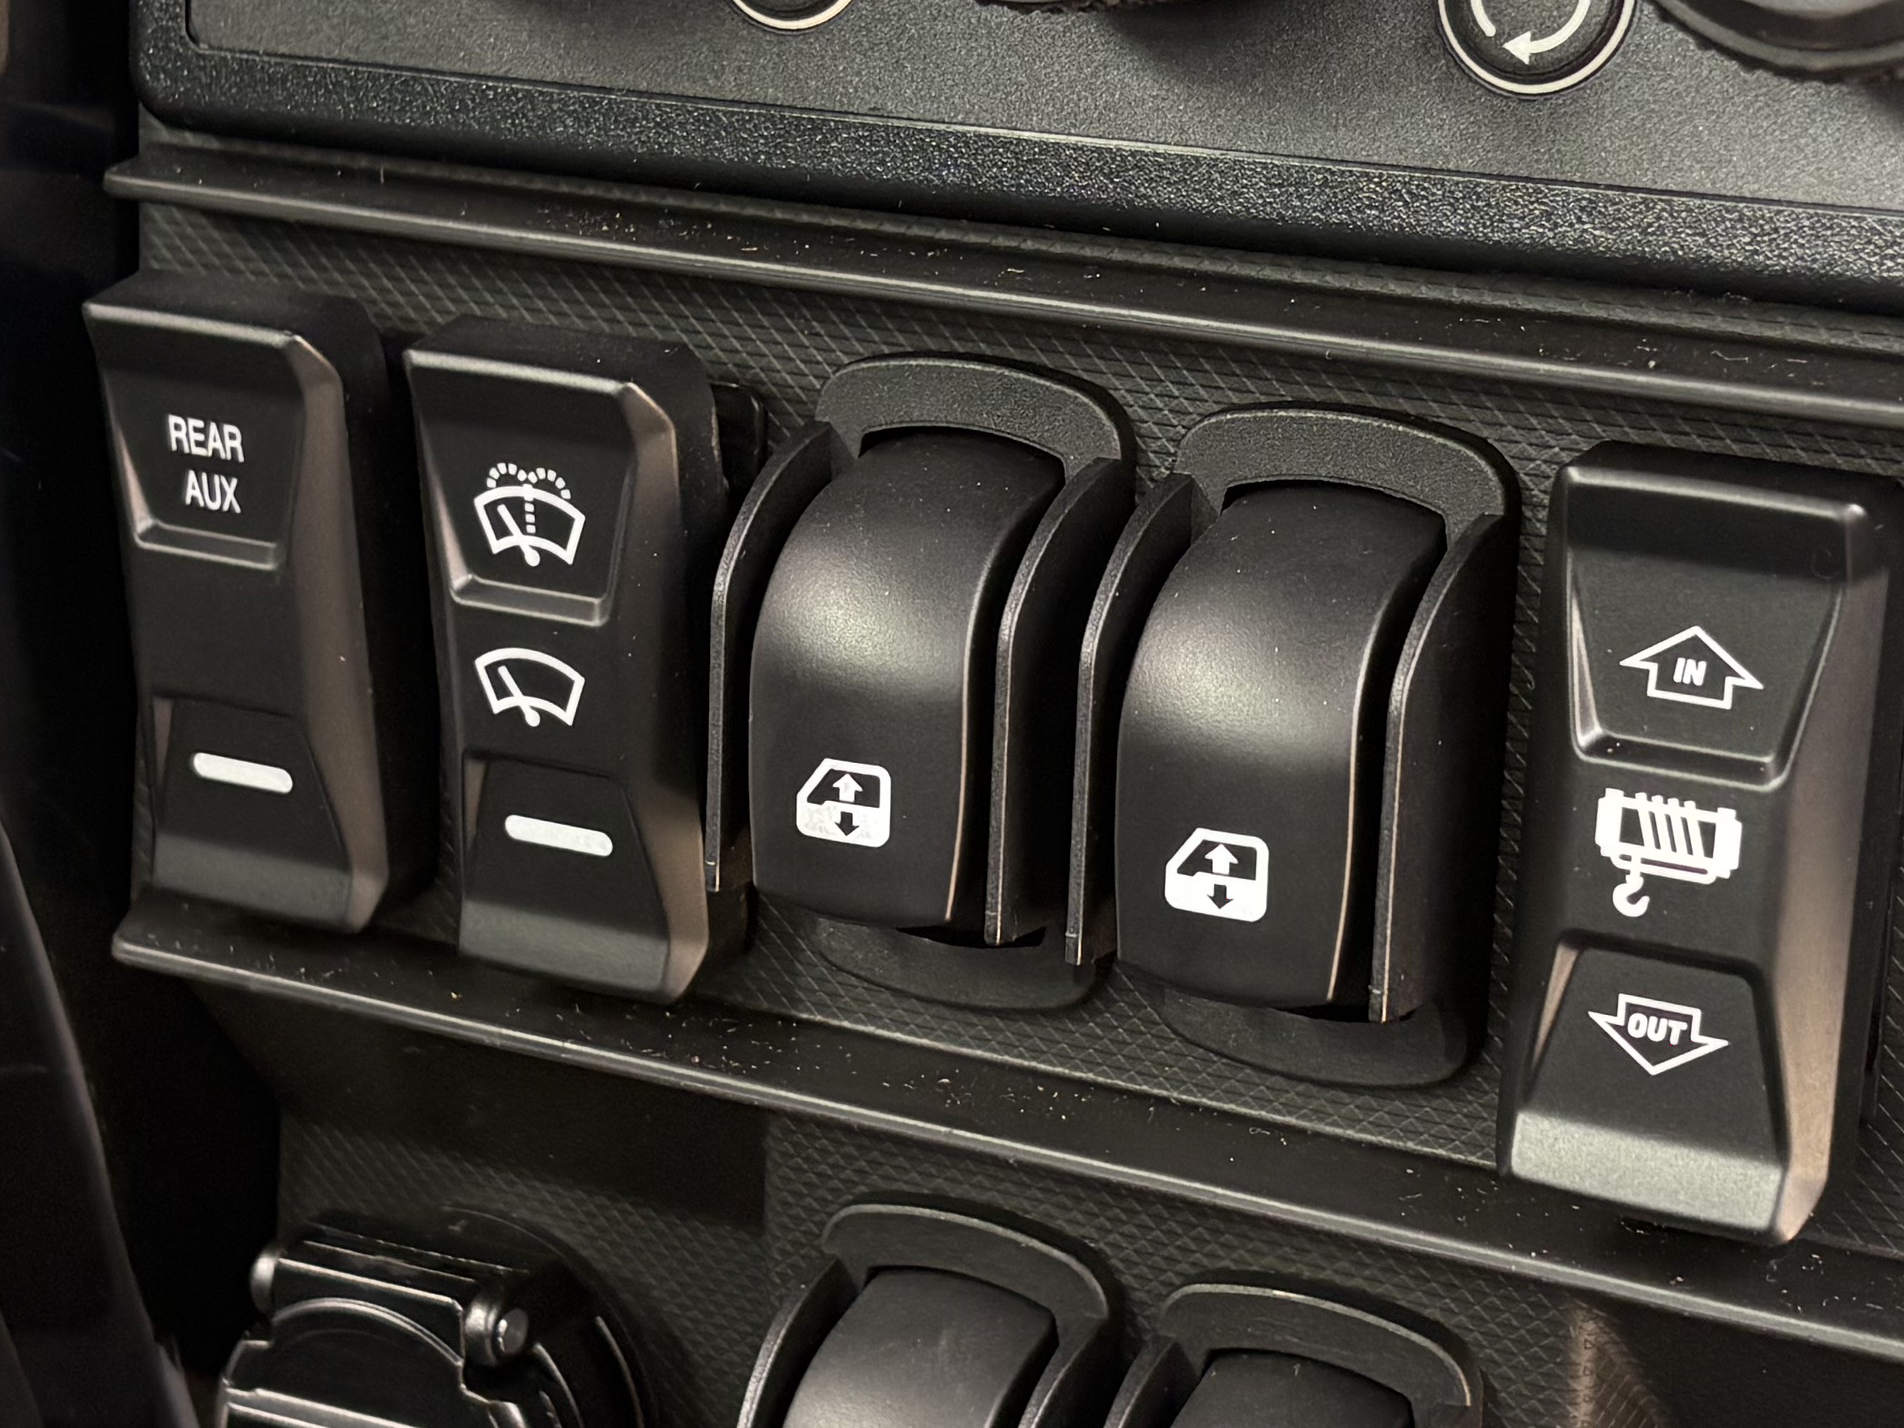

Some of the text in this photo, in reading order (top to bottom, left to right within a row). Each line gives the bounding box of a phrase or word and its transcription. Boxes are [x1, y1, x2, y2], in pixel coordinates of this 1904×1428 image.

[167, 414, 244, 463] REAR
[185, 469, 241, 514] AUX
[1673, 657, 1705, 685] IN
[1626, 1013, 1688, 1046] OUT
